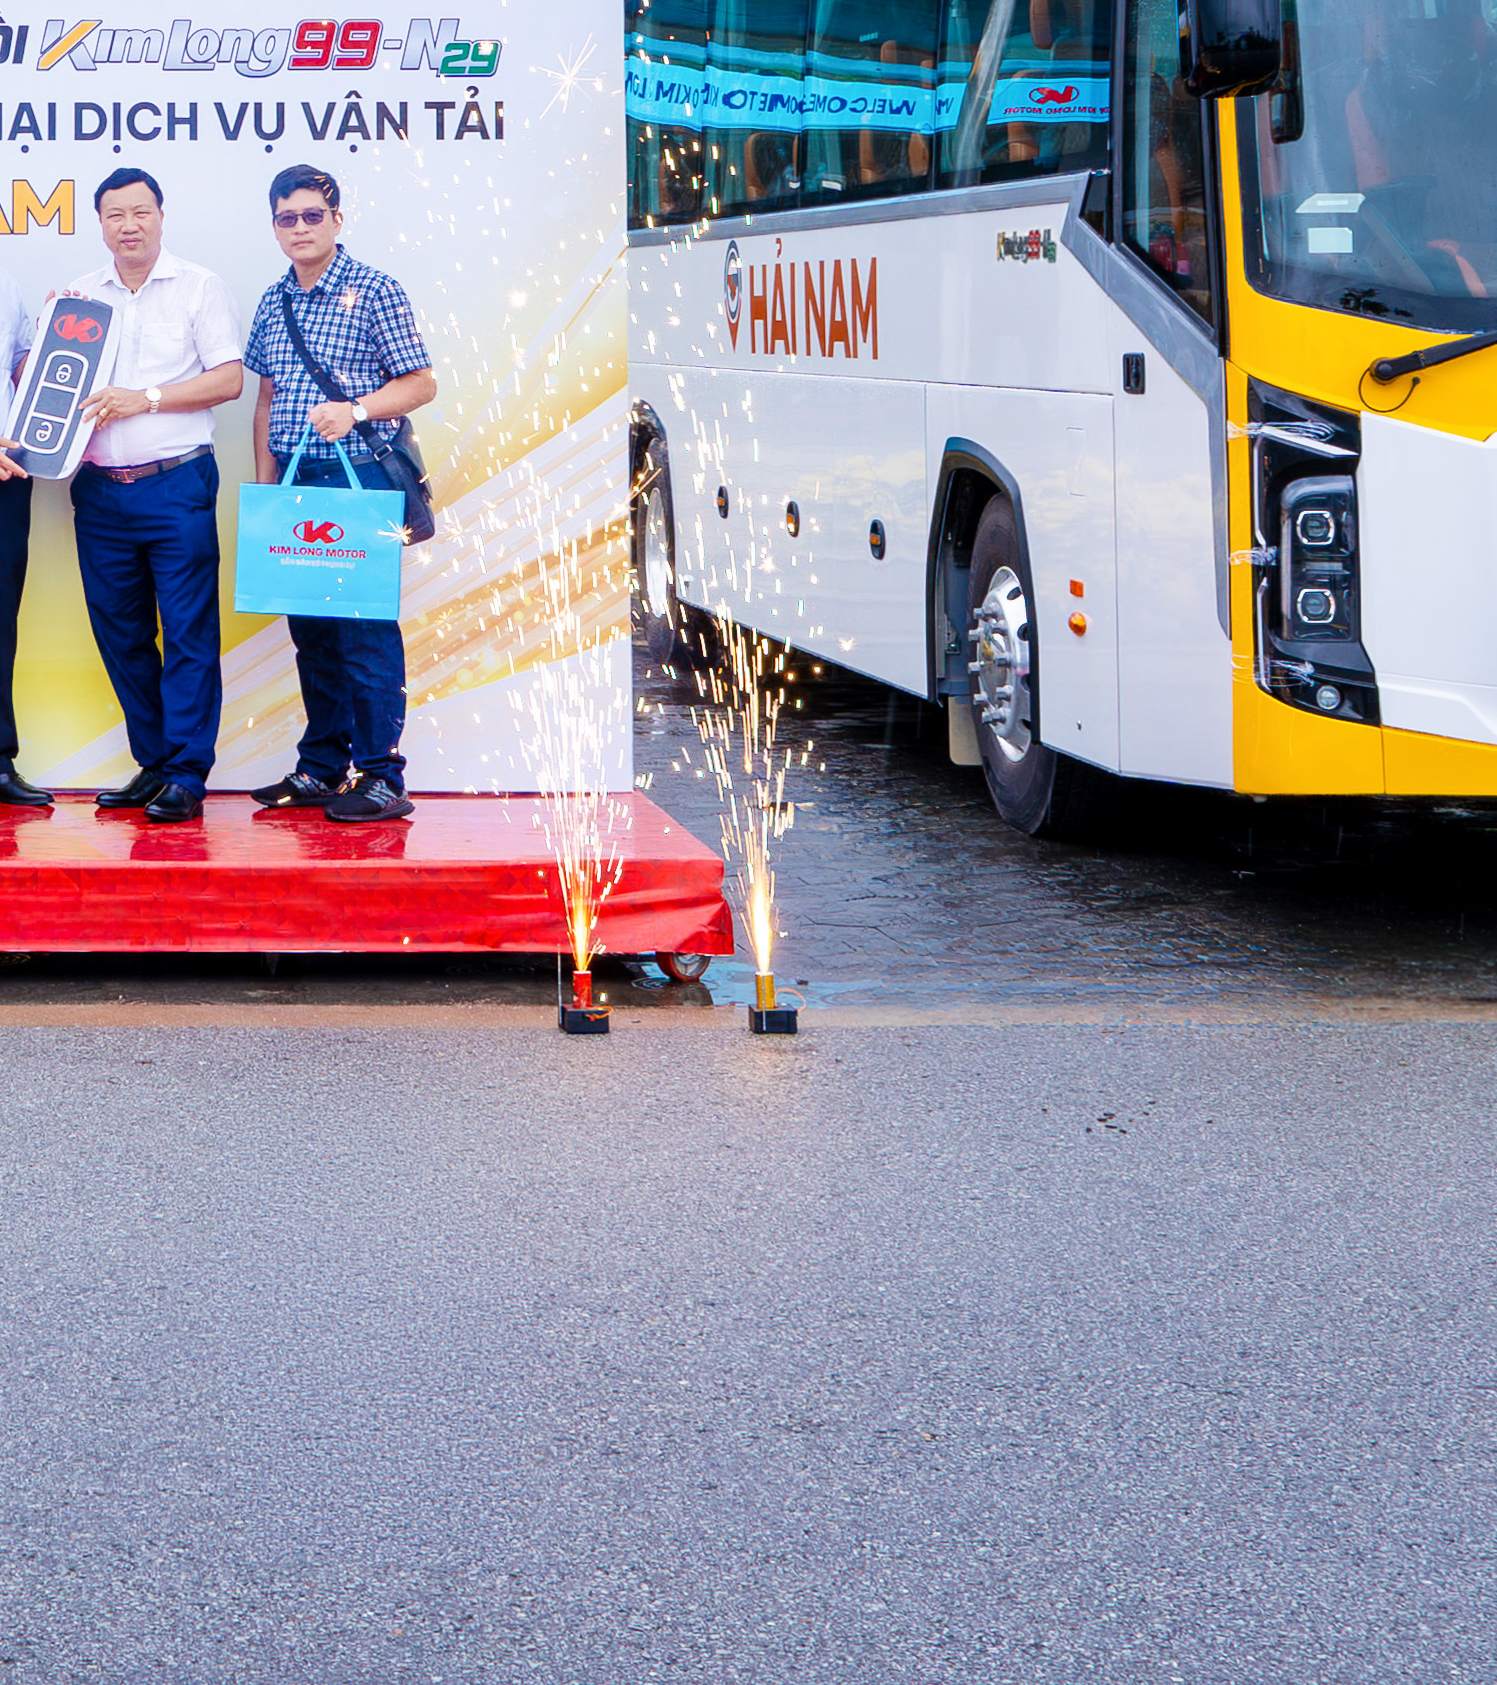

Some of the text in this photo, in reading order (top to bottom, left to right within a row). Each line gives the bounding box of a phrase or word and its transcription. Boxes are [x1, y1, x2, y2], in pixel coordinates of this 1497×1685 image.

[75, 101, 197, 153] DỊCH
[214, 101, 287, 153] VỤ
[300, 96, 418, 153] VẬN
[424, 85, 505, 141] TẢI
[749, 237, 879, 360] HẢI NAM
[269, 545, 367, 559] KIM LONG MOTOR
